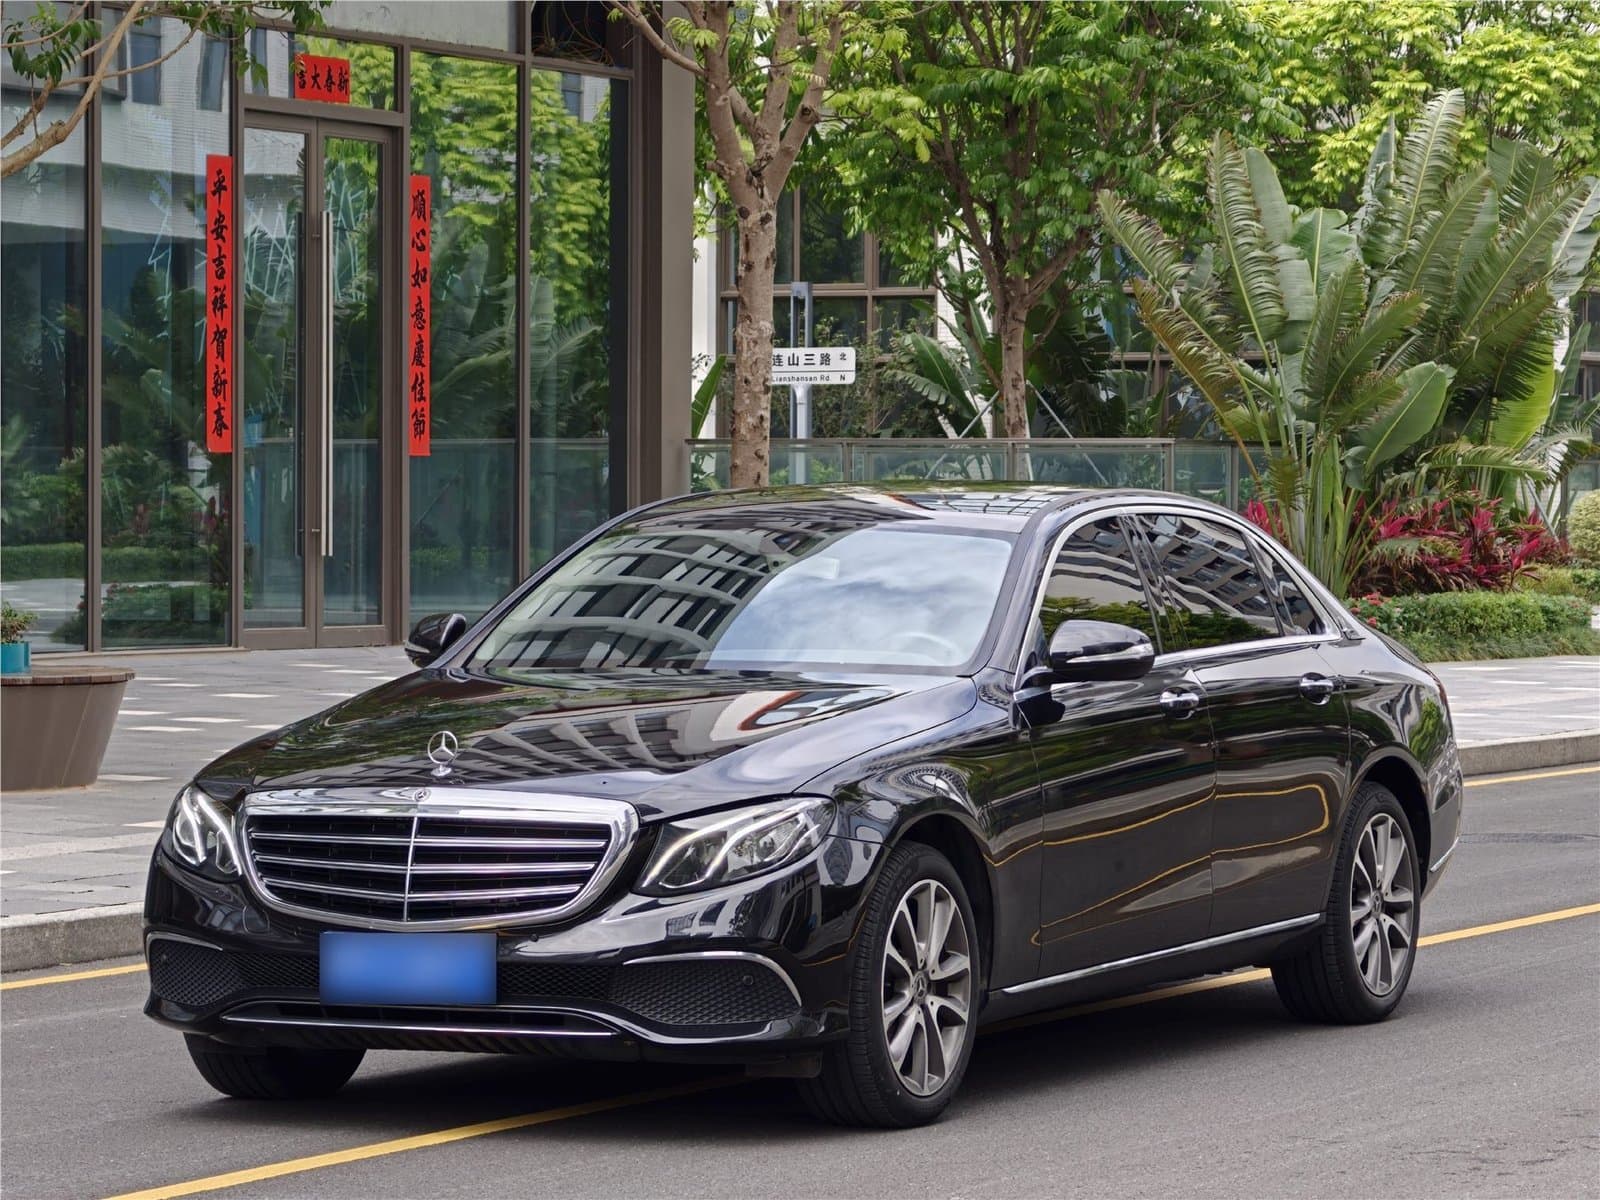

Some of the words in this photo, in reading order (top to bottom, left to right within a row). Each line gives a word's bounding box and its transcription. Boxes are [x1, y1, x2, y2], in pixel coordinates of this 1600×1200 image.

[210, 169, 230, 438] 平安吉祥賀新春
[772, 352, 831, 367] 连山三路
[839, 352, 847, 361] 北
[839, 373, 846, 381] N
